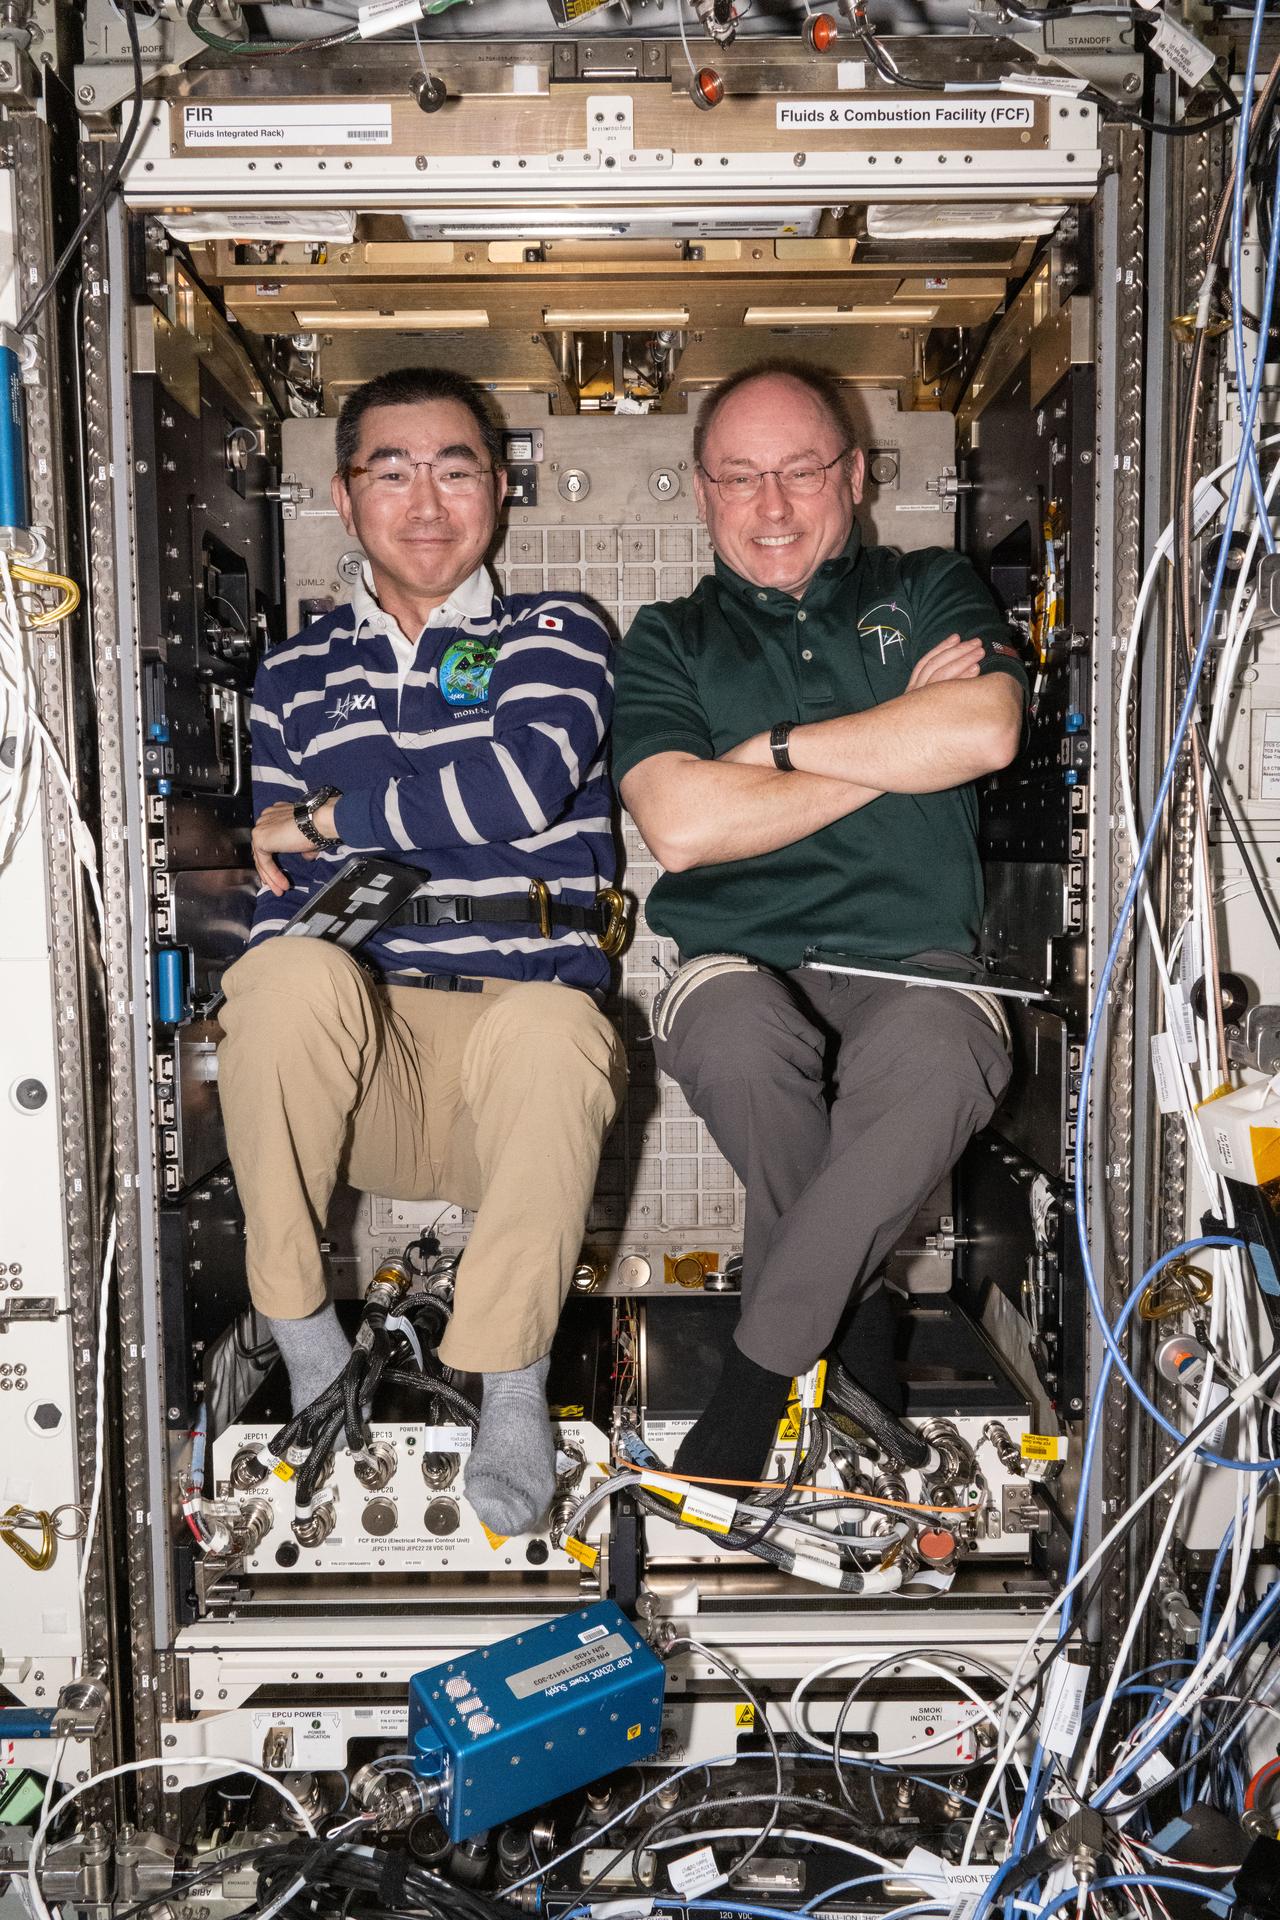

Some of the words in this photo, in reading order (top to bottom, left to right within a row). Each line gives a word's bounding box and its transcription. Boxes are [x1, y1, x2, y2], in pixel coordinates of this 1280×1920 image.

[1068, 36, 1111, 45] STANDOFF
[121, 46, 165, 54] STNDOFF
[186, 107, 214, 122] FIR
[780, 108, 825, 122] Fluids
[829, 109, 840, 122] &
[844, 108, 931, 122] Combustion
[935, 107, 987, 123] Facility
[990, 107, 1030, 123] (FCF)
[185, 129, 215, 139] (Fluids
[216, 129, 259, 140] Integrated
[260, 128, 285, 139] Rack)
[673, 513, 679, 521] H
[325, 692, 377, 730] JAXA
[243, 1432, 269, 1440] JEPC11
[592, 1645, 606, 1653] S/N
[596, 1651, 610, 1661] P/N
[592, 1665, 616, 1680] 120VDC
[569, 1674, 590, 1688] Power
[544, 1683, 568, 1697] Supply
[947, 1875, 978, 1885] VISION
[191, 1887, 213, 1897] ARIS
[719, 1911, 733, 1920] 120
[737, 1912, 753, 1920] VDC
